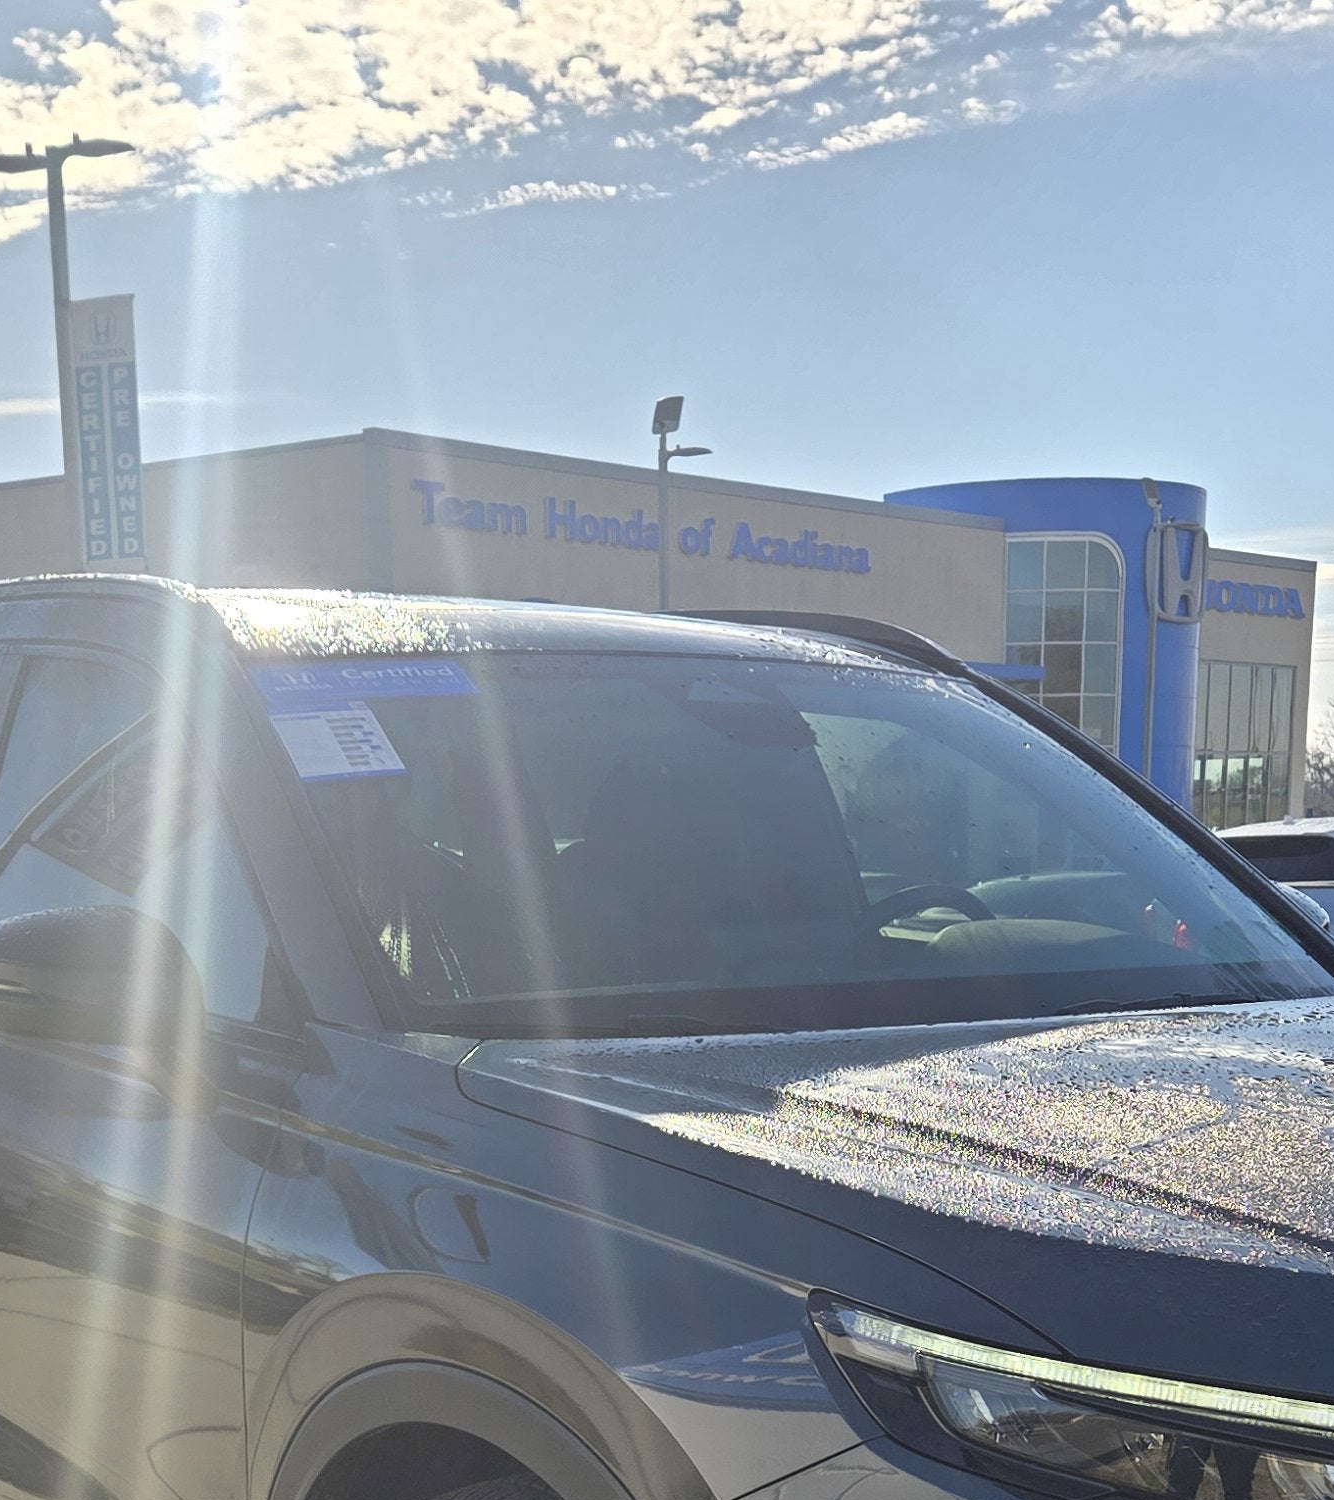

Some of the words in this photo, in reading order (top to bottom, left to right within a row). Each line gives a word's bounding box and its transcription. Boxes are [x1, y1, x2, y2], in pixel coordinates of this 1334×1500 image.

[113, 366, 131, 427] PRE
[79, 370, 107, 557] CERTIFIED
[116, 452, 141, 555] OWNED
[411, 478, 527, 535] Team
[546, 496, 660, 551] Honda
[679, 517, 715, 557] of
[728, 520, 872, 575] Acadiana
[341, 664, 455, 681] Certified
